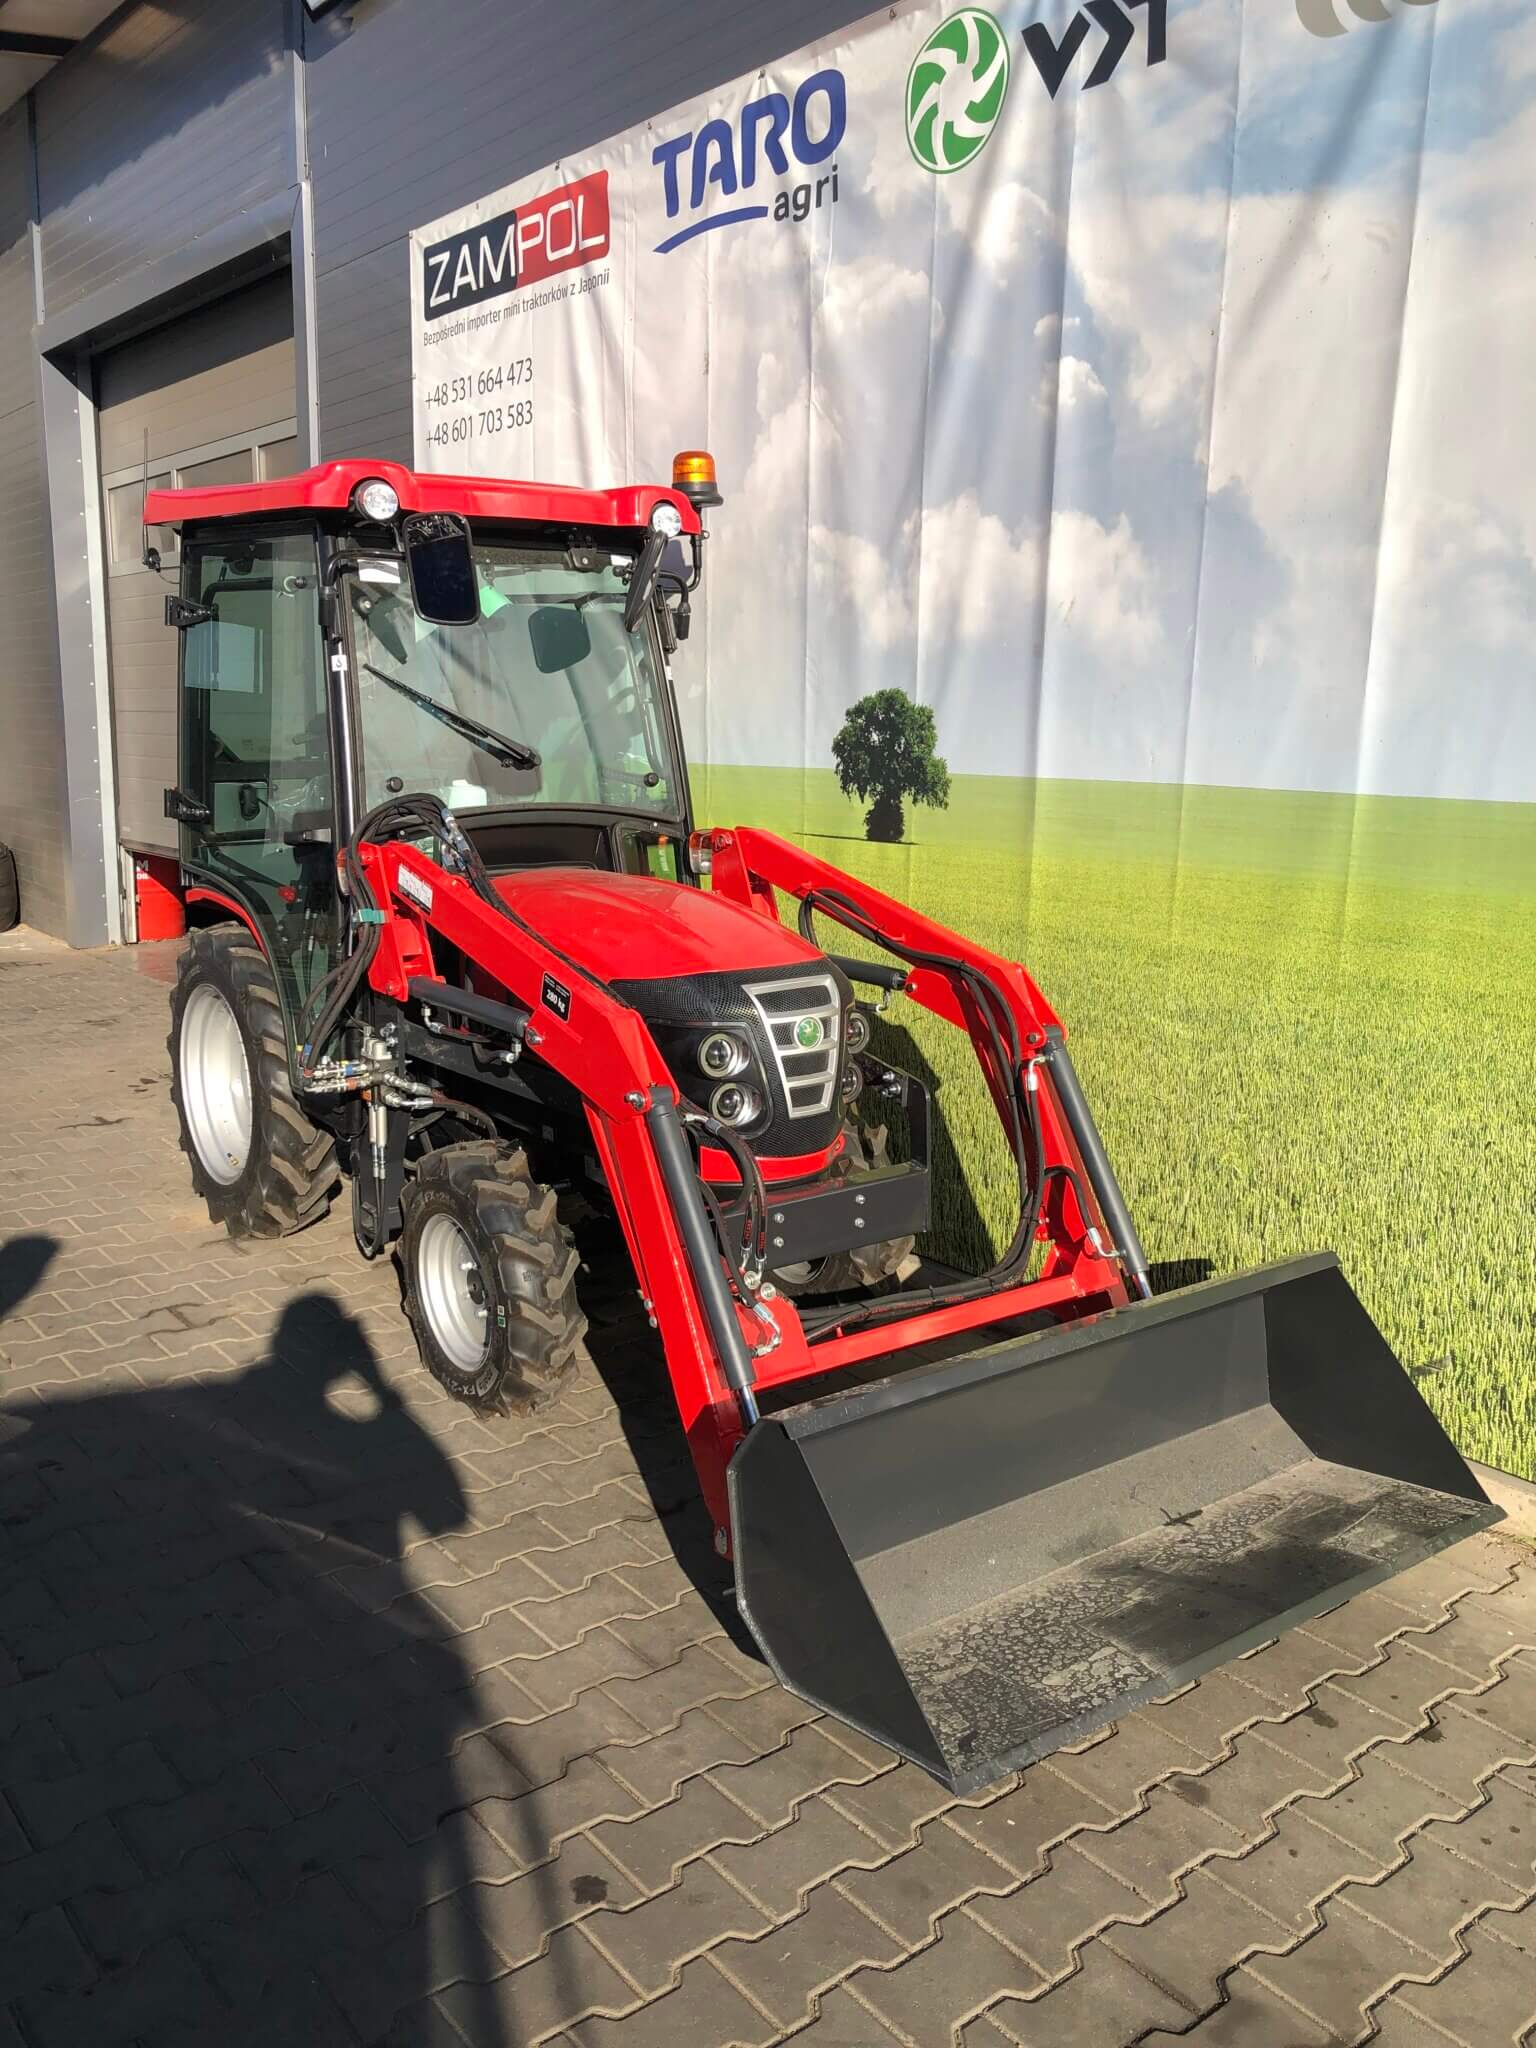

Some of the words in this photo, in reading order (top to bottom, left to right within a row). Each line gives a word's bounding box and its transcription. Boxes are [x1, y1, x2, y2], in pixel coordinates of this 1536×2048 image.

[652, 69, 847, 218] TARO
[773, 164, 839, 222] agri
[428, 194, 605, 308] ZAMPOL
[467, 308, 502, 332] importer
[503, 299, 520, 321] mini
[522, 284, 569, 313] traktorków
[570, 282, 576, 296] z
[578, 268, 610, 294] Japonii
[425, 382, 449, 410] +48
[451, 375, 473, 404] 531
[477, 365, 504, 396] 664
[506, 357, 533, 387] 473
[426, 422, 449, 449] +48
[452, 415, 473, 443] 601
[478, 408, 503, 436] 703
[507, 400, 533, 430] 583
